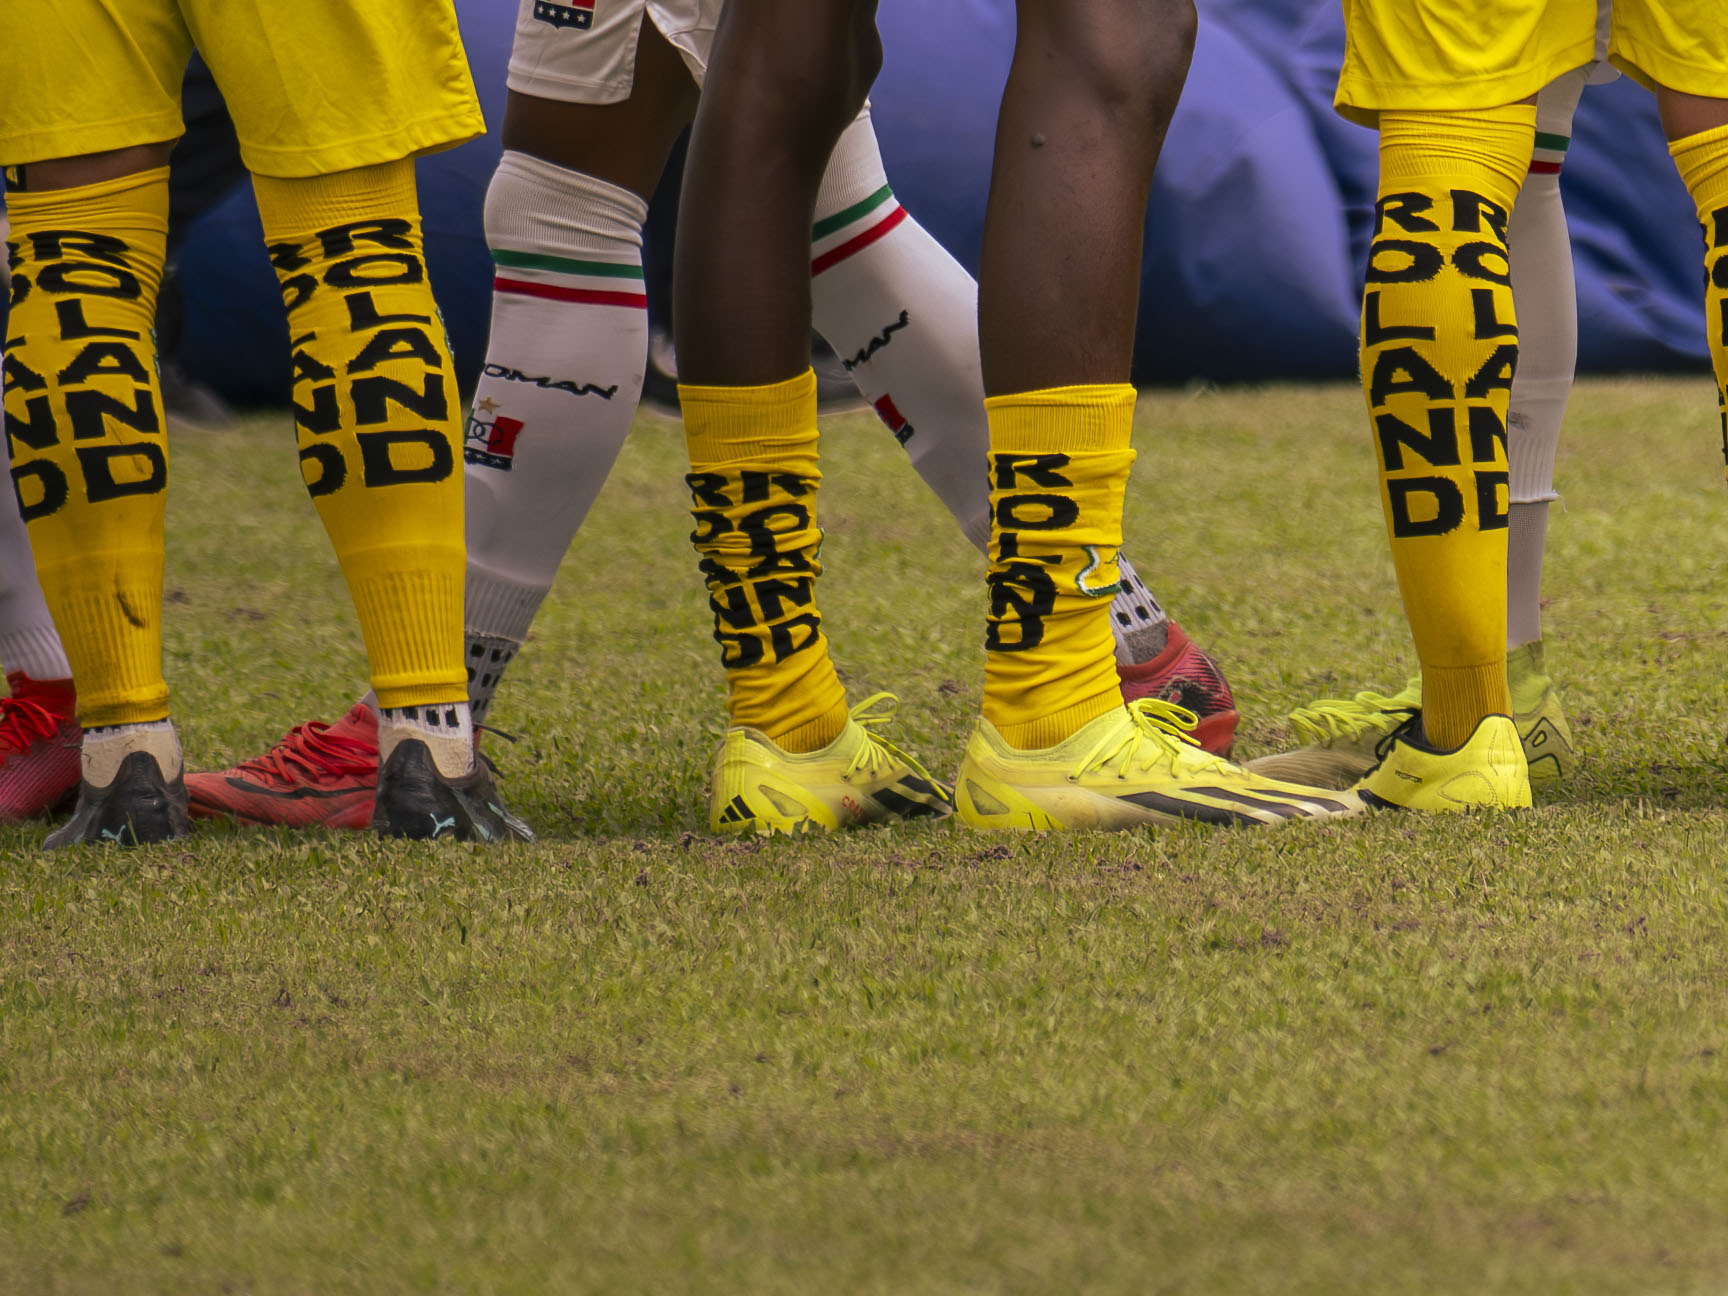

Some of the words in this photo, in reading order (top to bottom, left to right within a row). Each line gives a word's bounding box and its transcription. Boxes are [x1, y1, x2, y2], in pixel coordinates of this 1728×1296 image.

[26, 229, 169, 504] ROLAND
[315, 218, 454, 488] ROLAND
[1364, 191, 1466, 538] ROLAND
